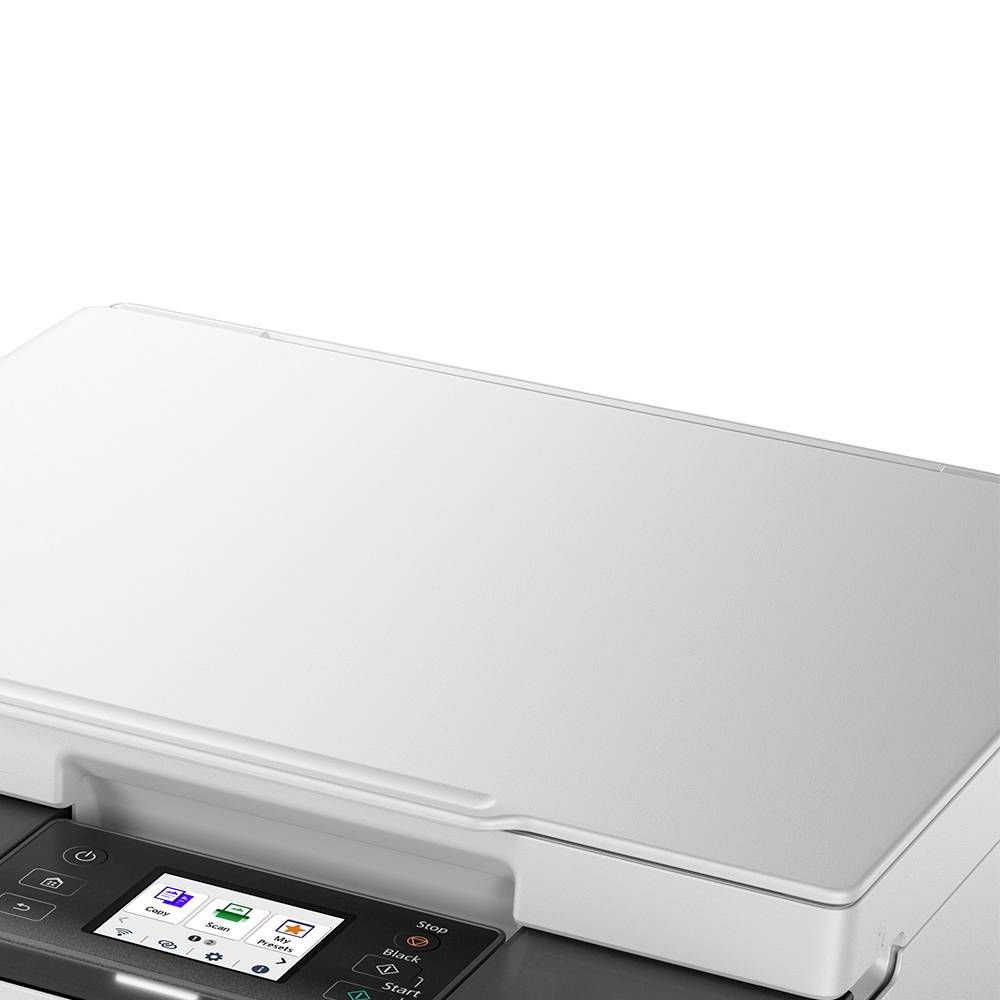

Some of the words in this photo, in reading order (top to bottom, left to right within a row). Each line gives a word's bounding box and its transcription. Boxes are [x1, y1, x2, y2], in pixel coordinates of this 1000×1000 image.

[145, 905, 170, 917] Copy
[205, 921, 230, 933] Scan
[416, 920, 448, 934] Stop
[257, 939, 294, 954] Presets
[274, 935, 291, 945] My
[382, 948, 421, 964] Black
[381, 982, 422, 998] Start
